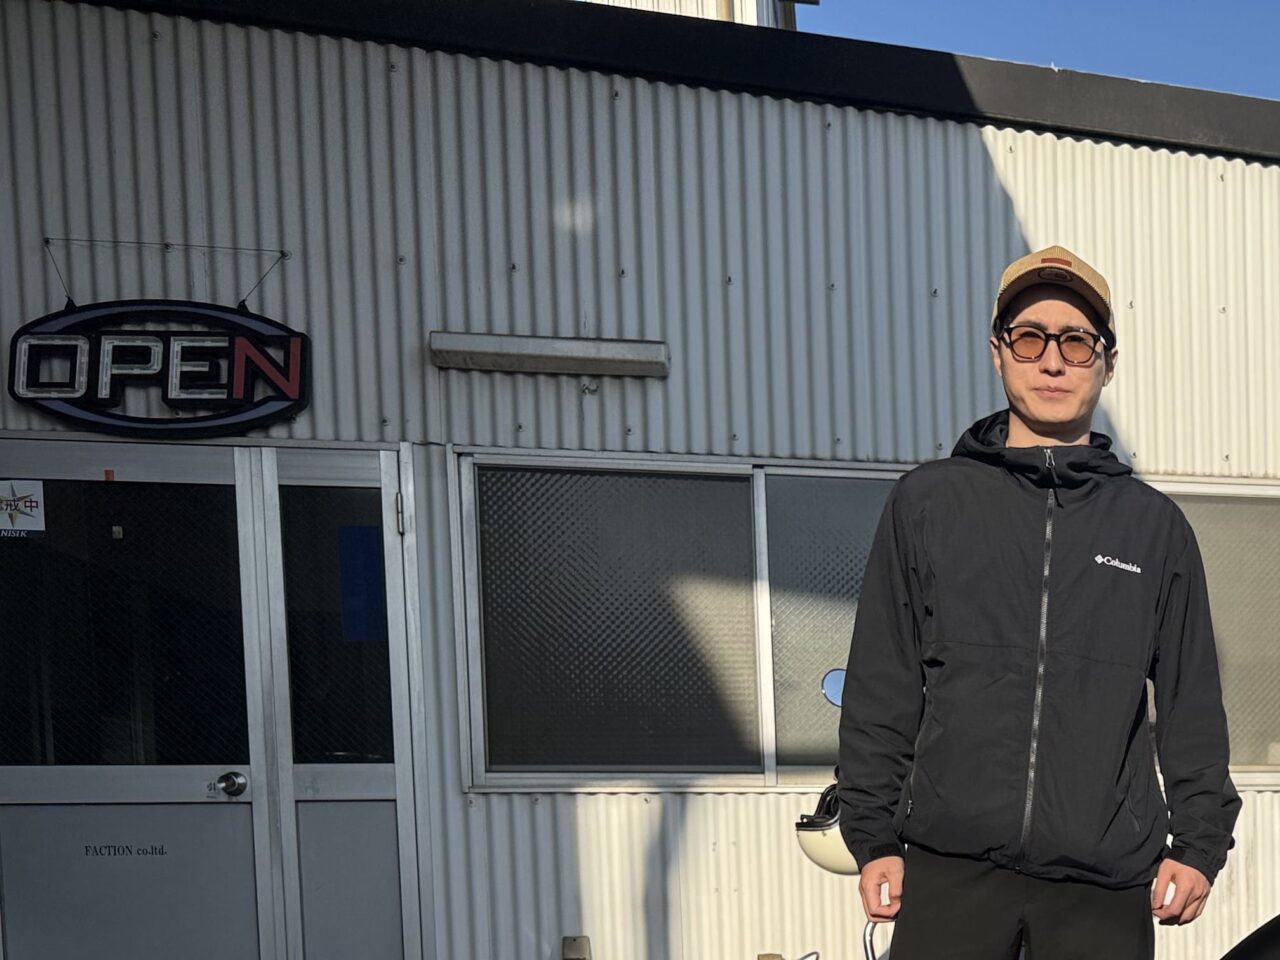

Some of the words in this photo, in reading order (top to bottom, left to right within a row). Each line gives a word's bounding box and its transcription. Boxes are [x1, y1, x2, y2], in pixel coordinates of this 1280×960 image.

[14, 334, 302, 400] OPEN
[0, 497, 38, 512] 戒中
[1104, 556, 1142, 574] Columbia
[84, 845, 133, 856] FACTION
